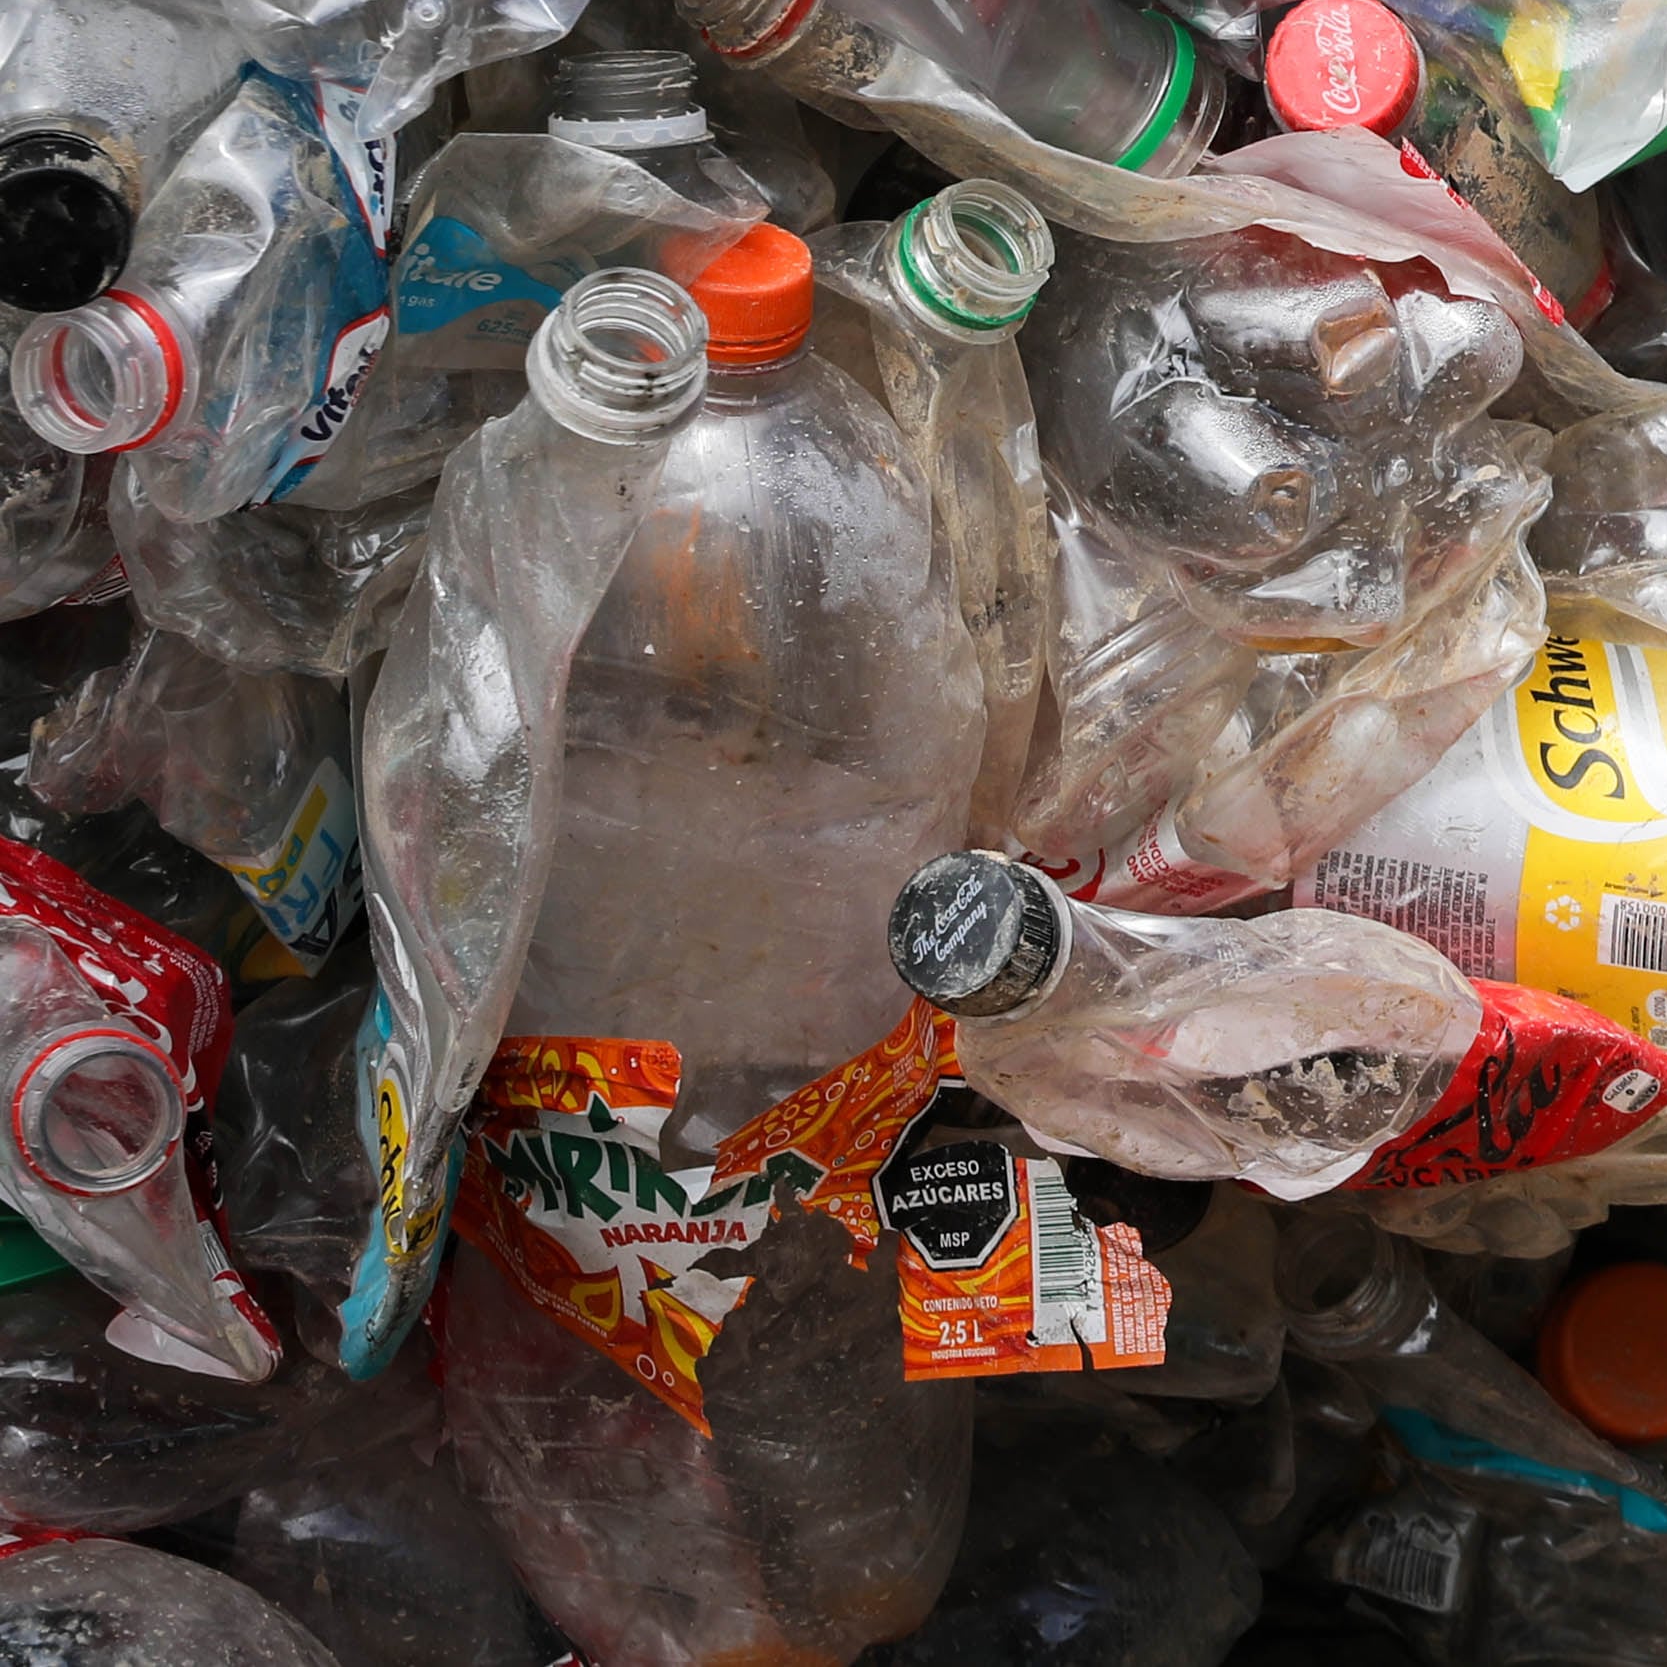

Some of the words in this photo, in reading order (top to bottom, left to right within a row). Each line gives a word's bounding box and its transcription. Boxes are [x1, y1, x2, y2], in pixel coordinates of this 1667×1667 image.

[934, 900, 988, 963] Company
[911, 929, 937, 966] The
[909, 1159, 981, 1183] EXCESO
[891, 1181, 1005, 1214] AZÚCARES
[600, 1219, 748, 1248] NARANJA
[939, 1232, 971, 1249] MSP
[923, 1295, 974, 1313] CONTENIDO
[973, 1320, 984, 1343] L
[931, 1348, 963, 1360] INDUSTRIA
